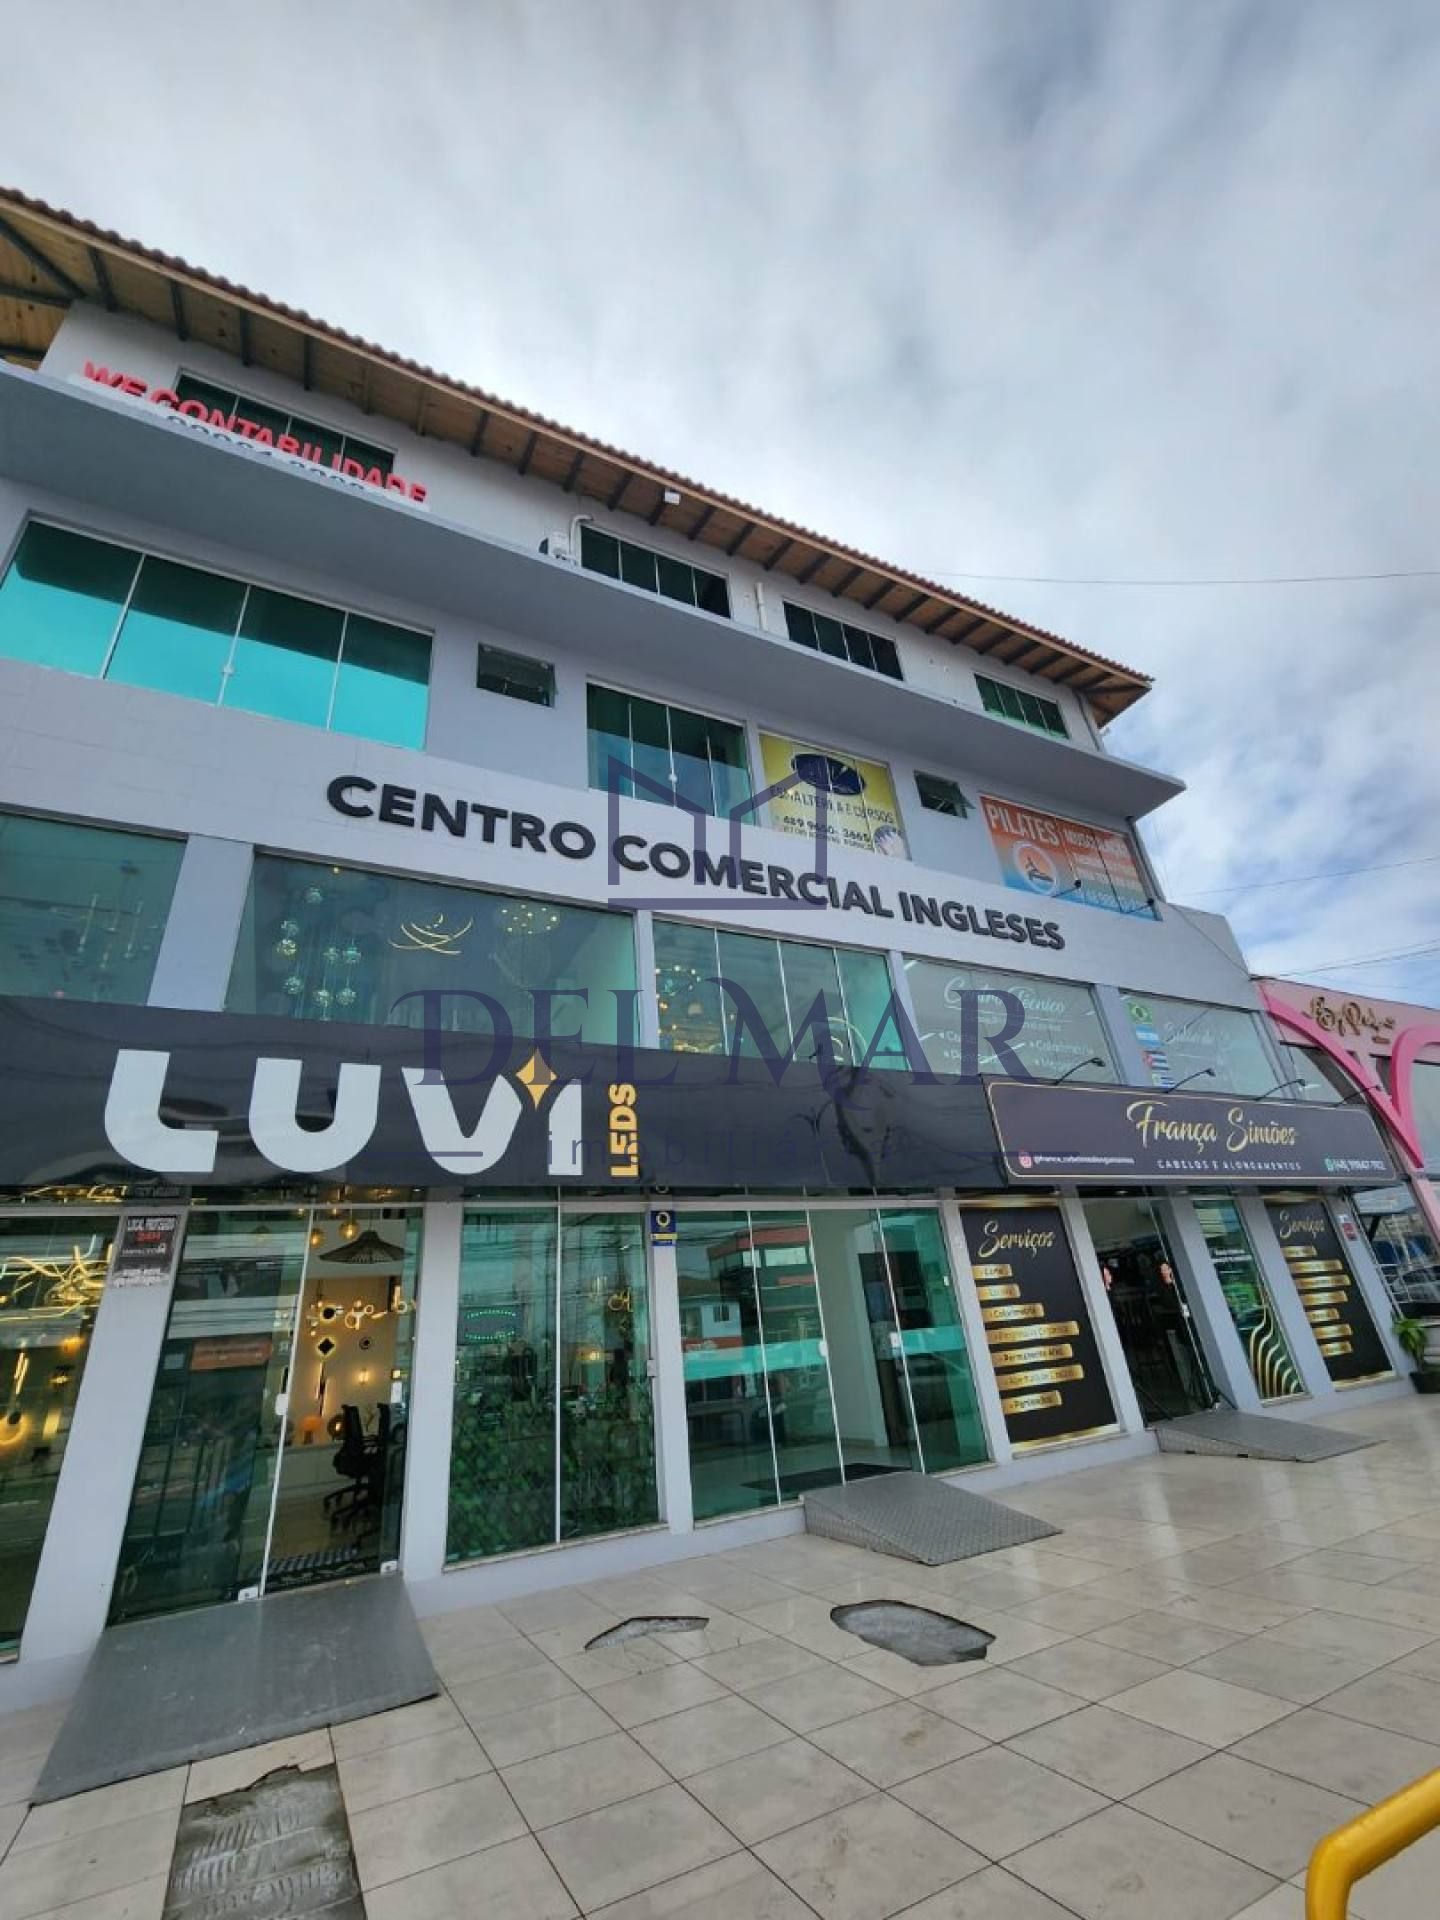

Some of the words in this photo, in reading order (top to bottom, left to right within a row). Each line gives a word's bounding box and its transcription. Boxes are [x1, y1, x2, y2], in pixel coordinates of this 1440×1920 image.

[84, 360, 147, 397] WE
[985, 804, 1061, 847] PILATES
[327, 775, 596, 860] CENTRO
[613, 834, 895, 919] COMERCIAL
[898, 891, 1066, 950] INGLESES
[608, 1083, 639, 1177] LEDS
[1126, 1100, 1217, 1153] França
[1226, 1107, 1298, 1152] Simões
[1156, 1159, 1209, 1170] CABELOS
[978, 1220, 1055, 1258] Serviços
[1279, 1210, 1325, 1240] Serviços
